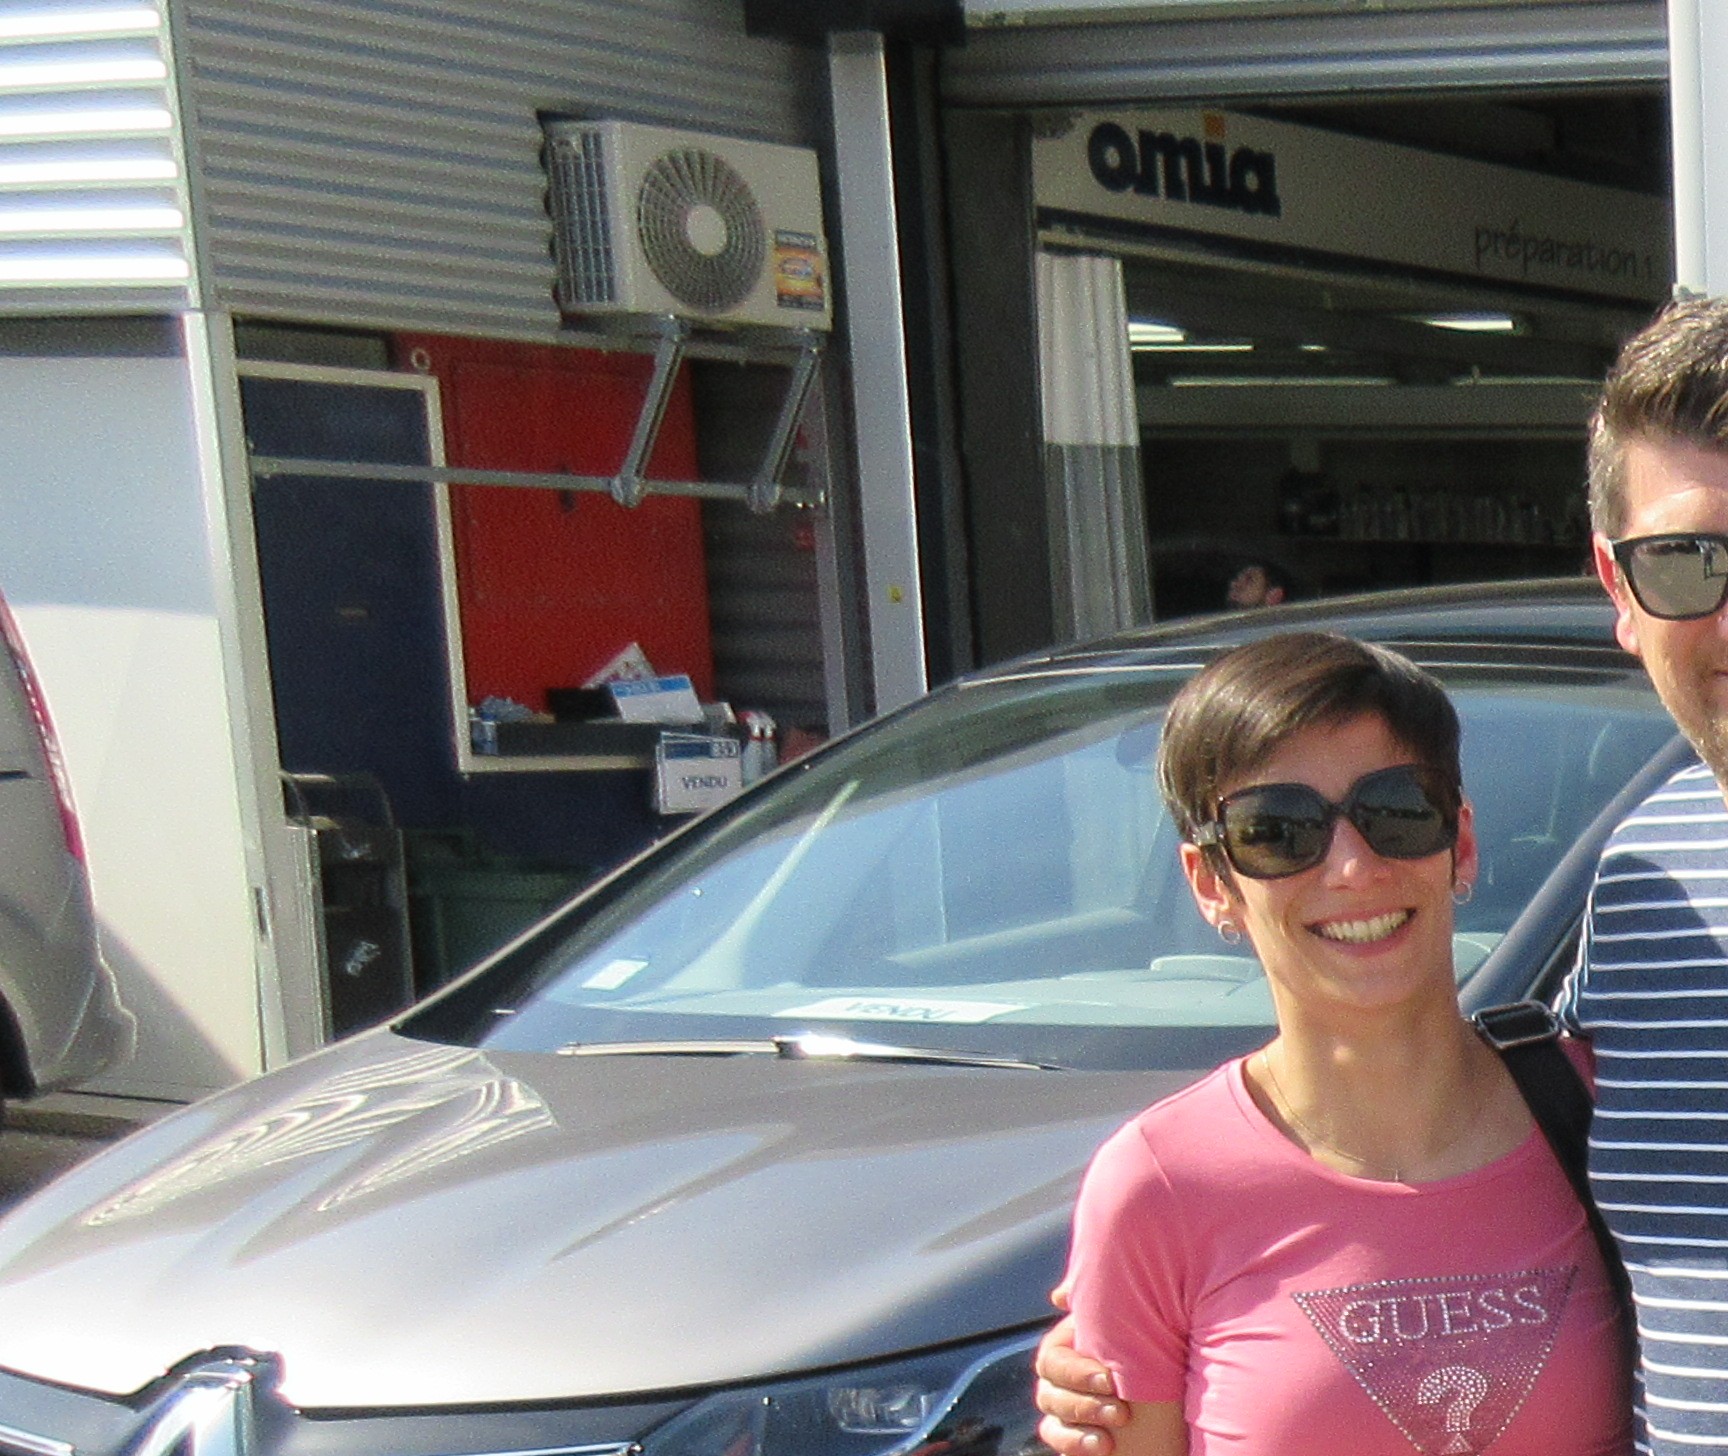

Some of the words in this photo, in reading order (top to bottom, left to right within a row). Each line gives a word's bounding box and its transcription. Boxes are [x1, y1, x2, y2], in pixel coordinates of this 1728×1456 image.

[1088, 110, 1281, 217] omia
[1475, 218, 1638, 278] préparation
[1339, 1285, 1548, 1343] GUESS
